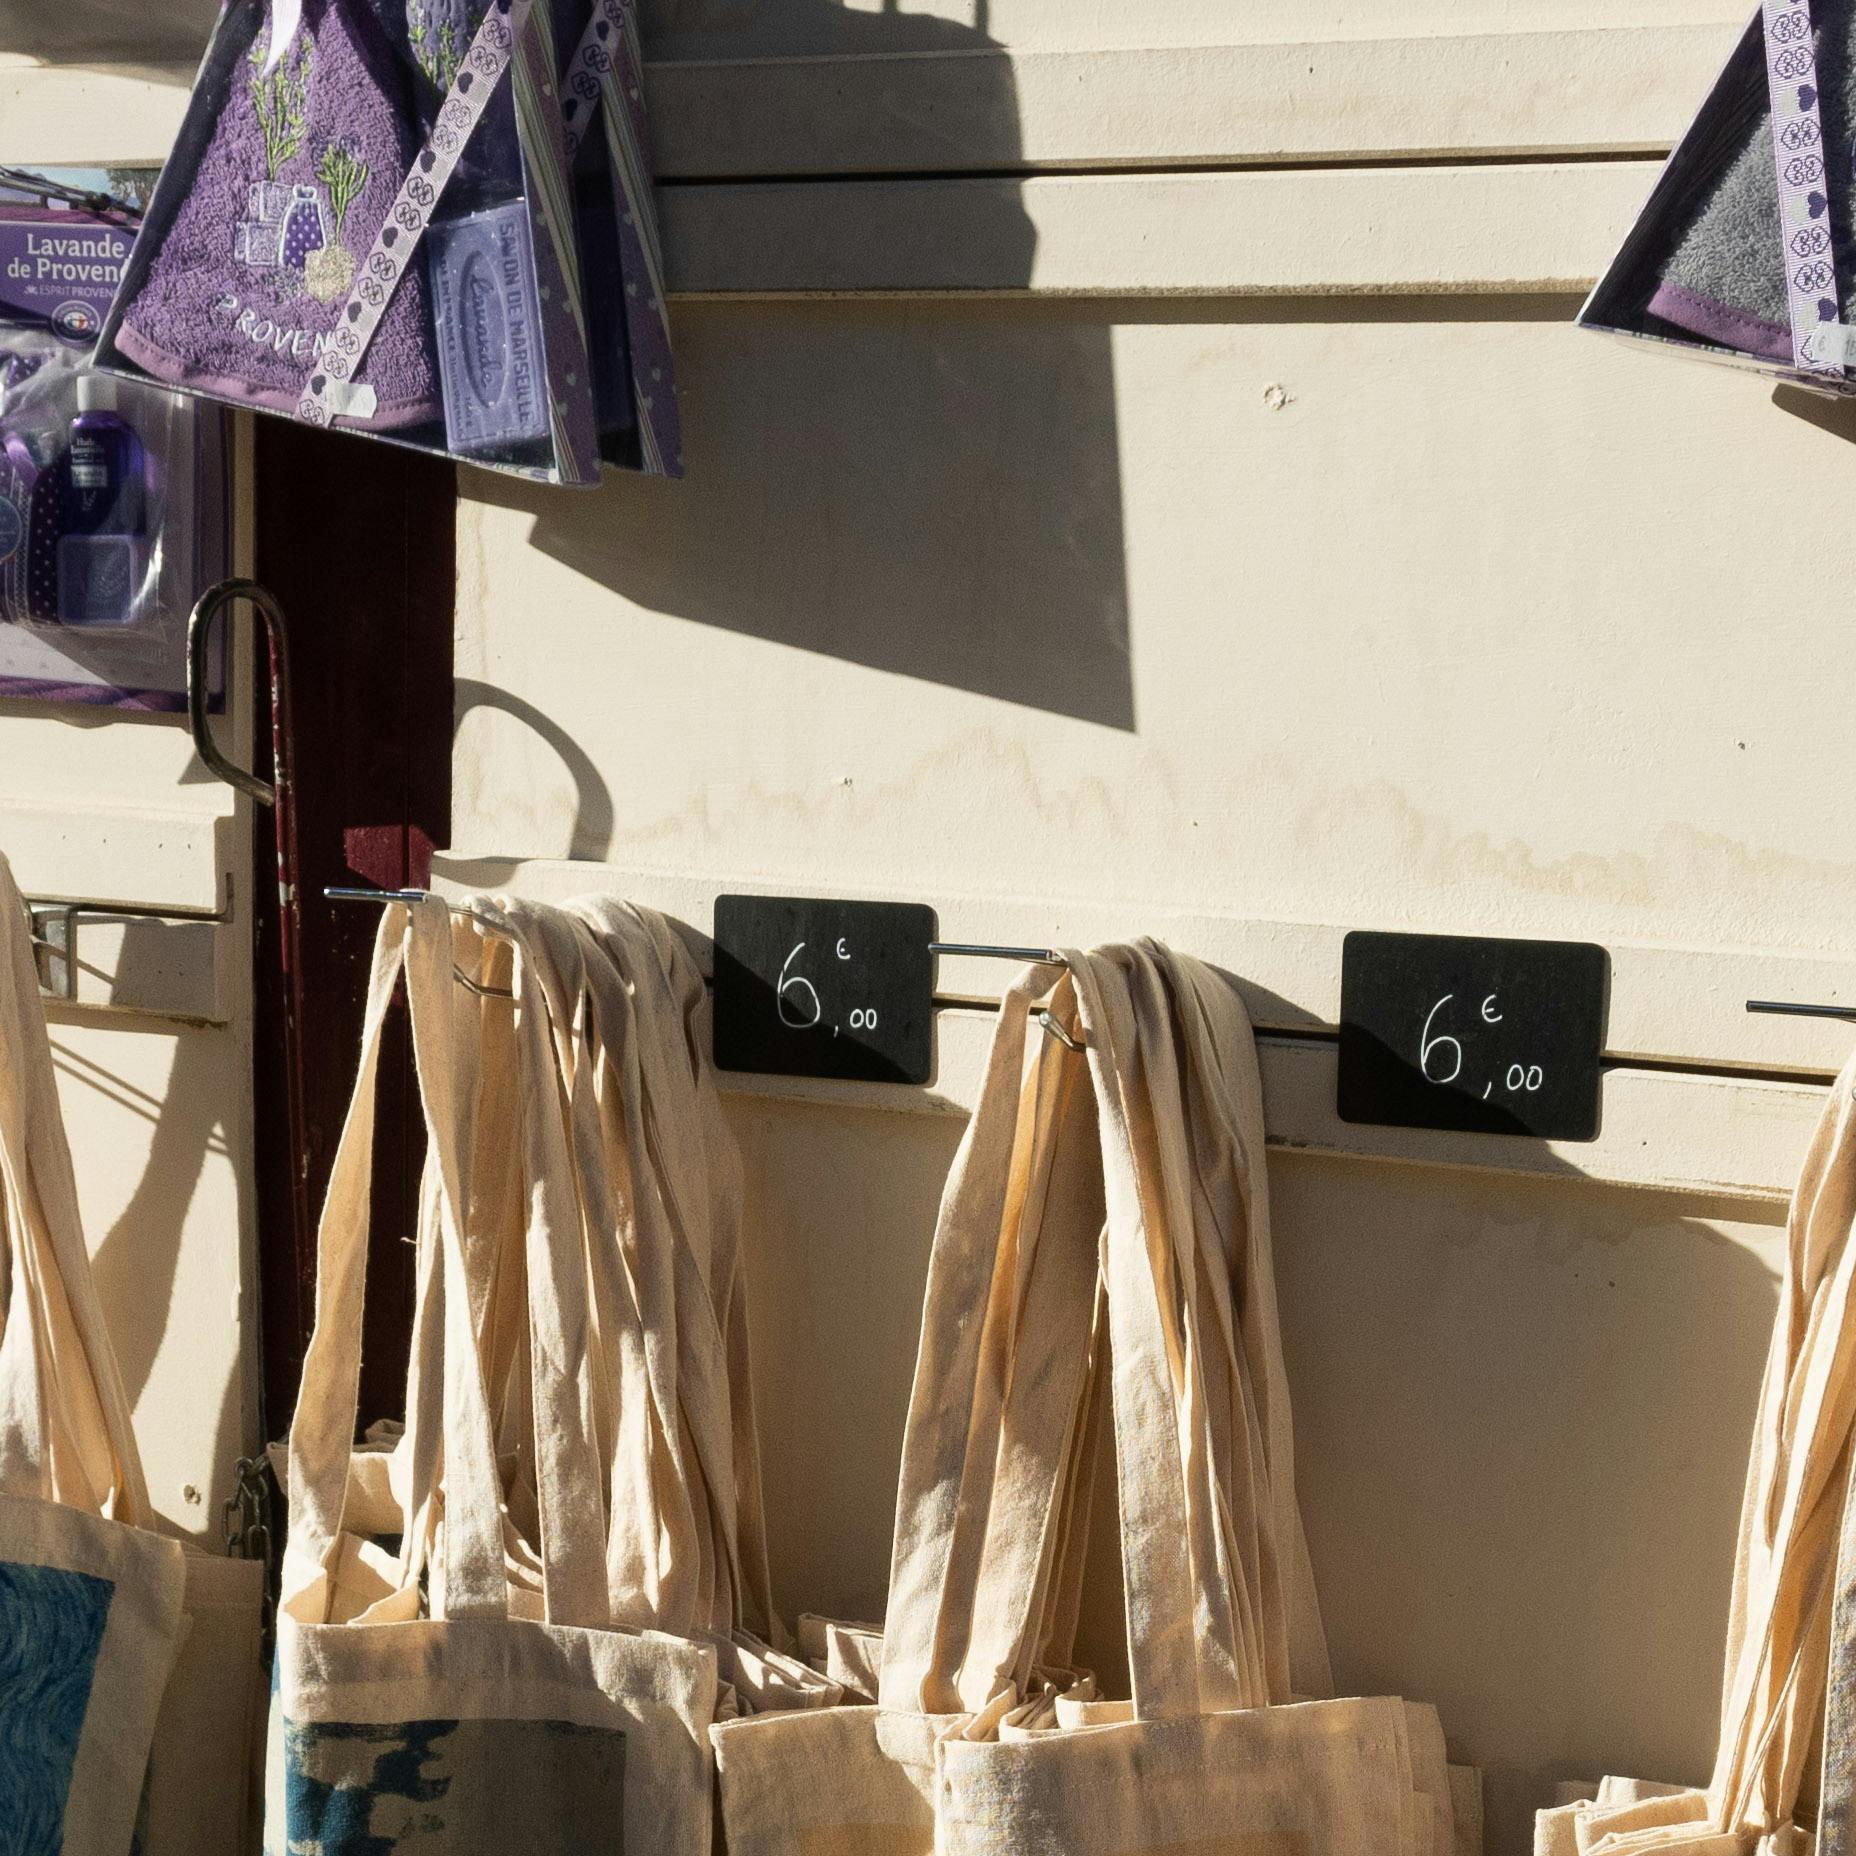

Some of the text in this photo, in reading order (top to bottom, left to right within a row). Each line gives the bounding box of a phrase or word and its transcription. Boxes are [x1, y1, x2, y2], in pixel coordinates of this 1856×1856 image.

[27, 233, 125, 259] Lavande
[7, 257, 124, 283] de Proven
[71, 286, 115, 299] PROVEN
[215, 293, 335, 358] PROVEN
[500, 222, 531, 425] SAVON DE MARSEILLE
